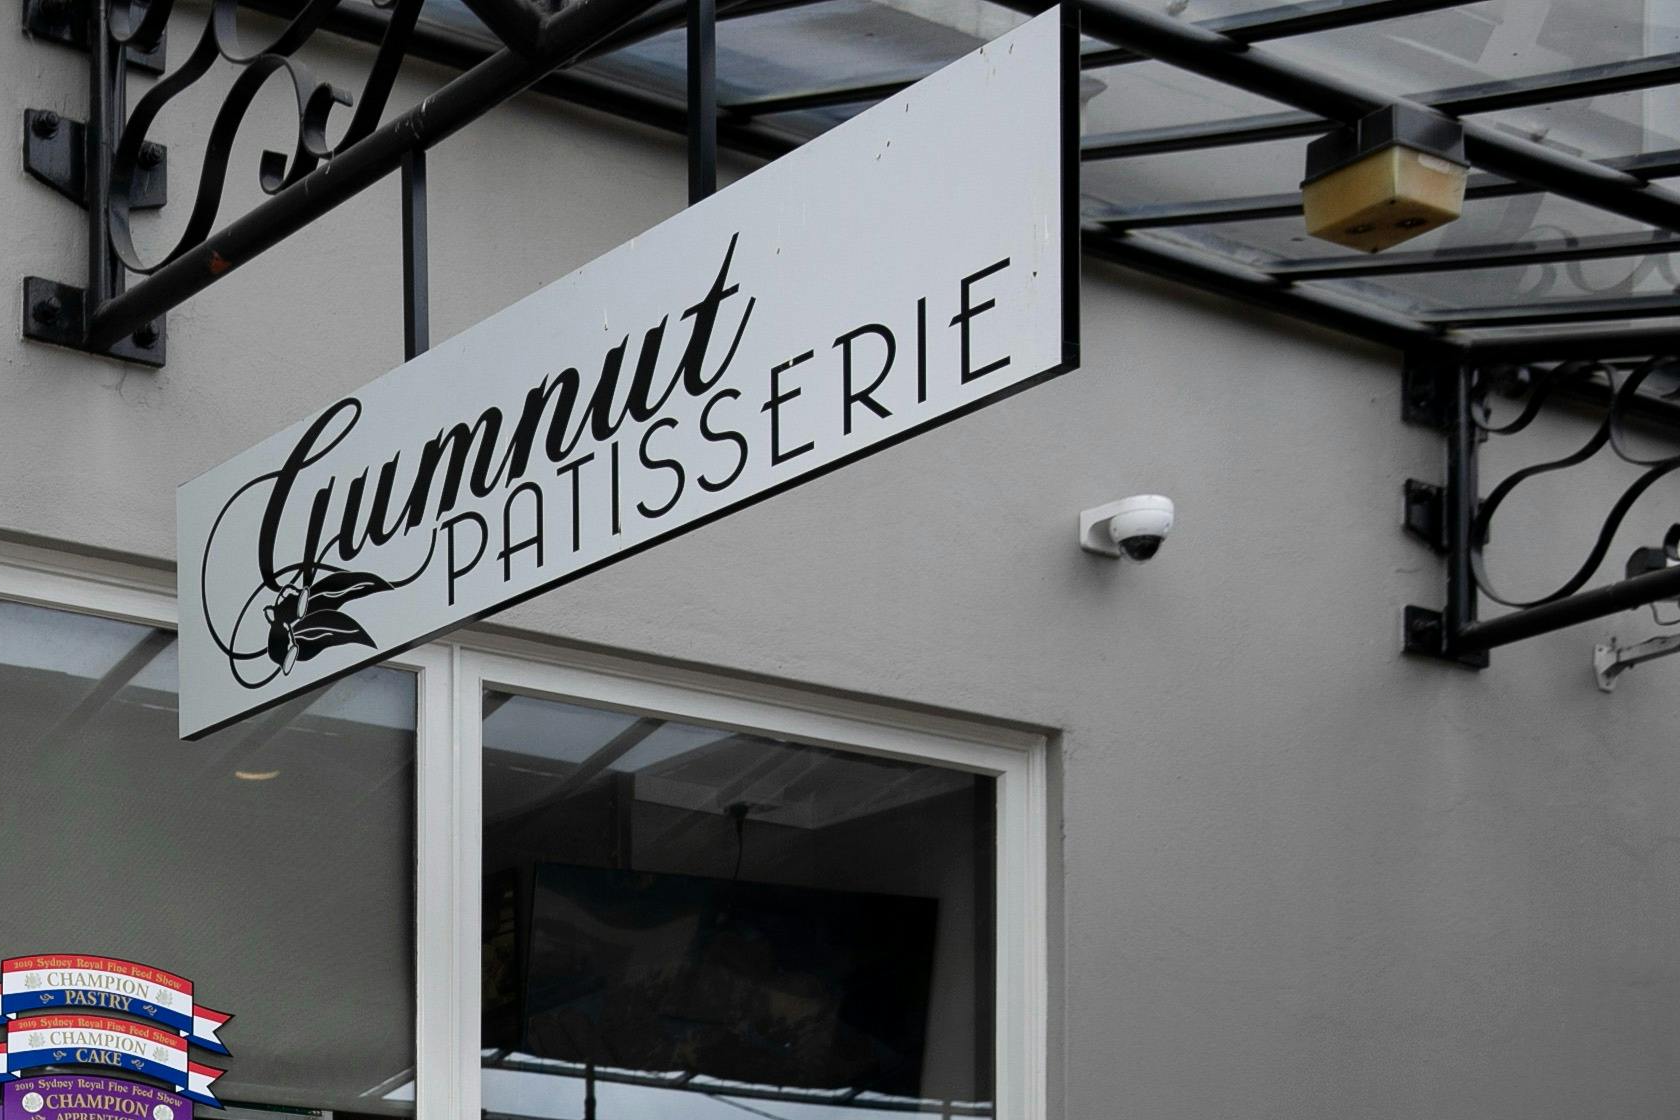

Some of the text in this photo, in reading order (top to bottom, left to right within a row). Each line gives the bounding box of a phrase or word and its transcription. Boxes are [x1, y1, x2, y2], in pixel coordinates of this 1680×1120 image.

[202, 232, 756, 650] Gumnut
[436, 256, 1011, 607] PATISSERIE
[14, 958, 181, 989] 2019 Sydney Royal Fine Food Show
[47, 971, 149, 999] CHAMPION
[64, 990, 134, 1011] PASTRY
[17, 1018, 178, 1046] 2019 Sydney Royal Fine Food Show
[50, 1031, 146, 1056] CHAMPION
[76, 1050, 122, 1066] CAKE
[15, 1079, 183, 1108] 2019 Sydney Royal Fine Food Show
[46, 1094, 149, 1118] CHAMPION
